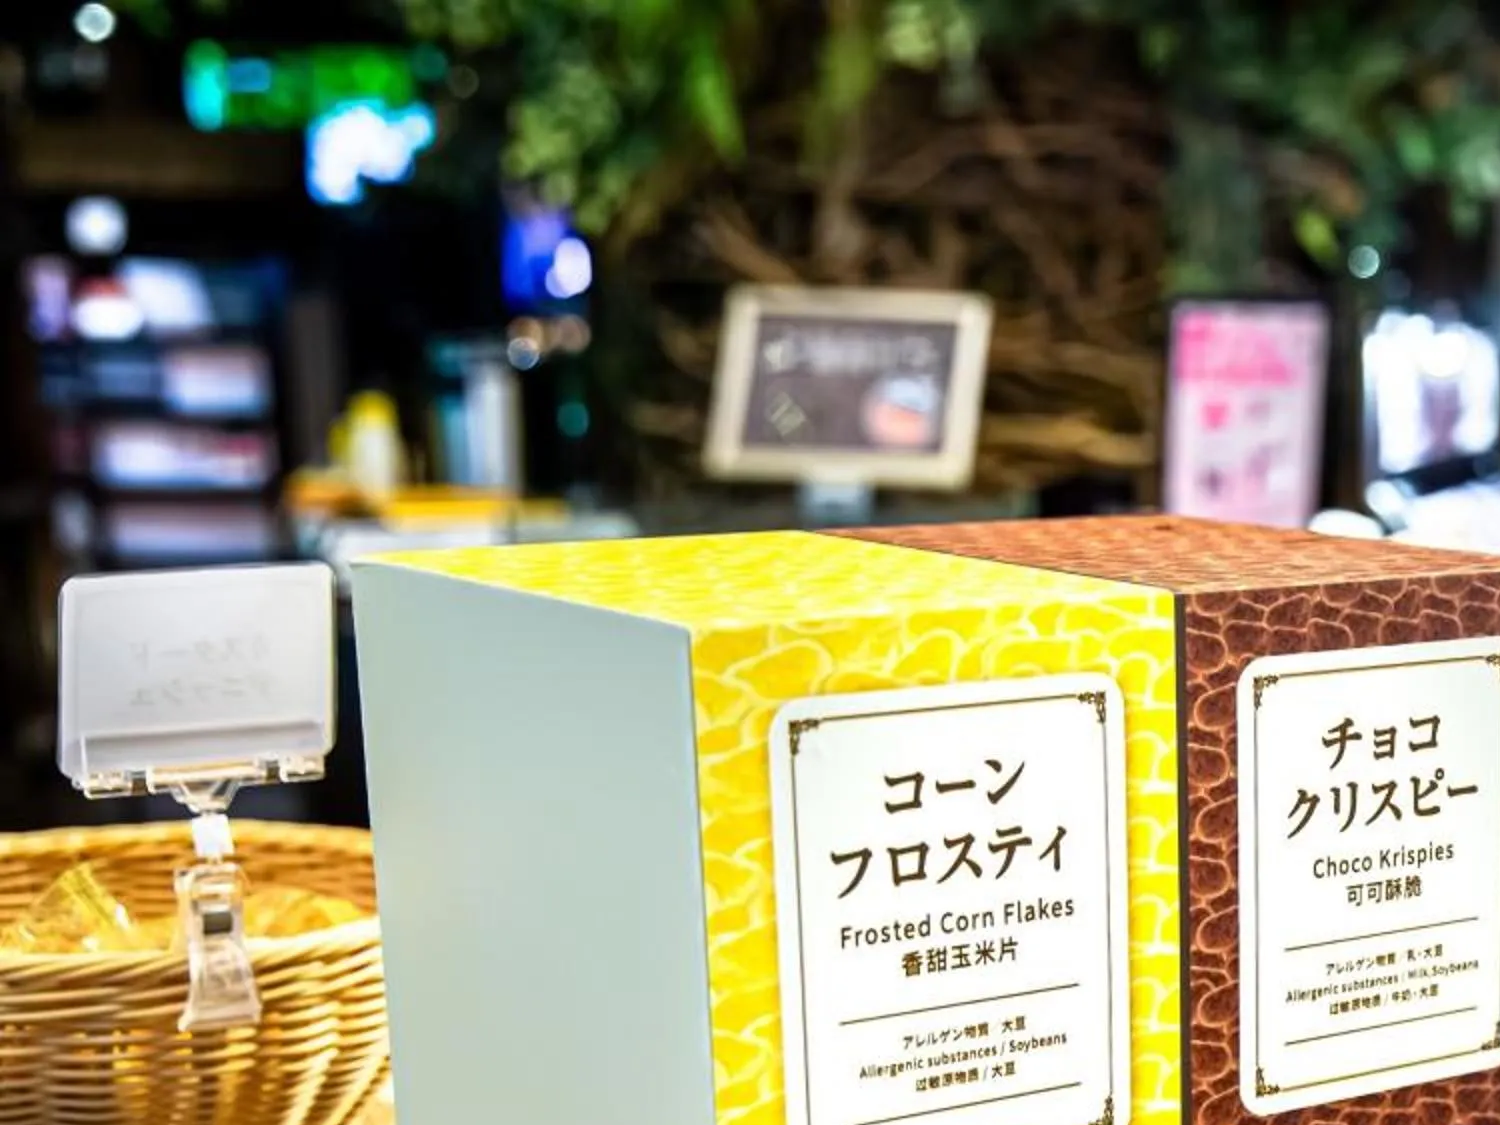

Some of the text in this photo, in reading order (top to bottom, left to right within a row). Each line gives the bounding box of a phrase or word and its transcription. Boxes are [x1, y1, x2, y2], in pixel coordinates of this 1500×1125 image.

[1321, 713, 1441, 770] チョコ
[883, 757, 1026, 814] コーン
[1287, 768, 1479, 840] クリスピー
[830, 824, 1069, 899] フロスティ
[1312, 841, 1455, 880] Choco Krispies
[1346, 875, 1422, 906] 可可酥脆
[840, 897, 1075, 950] Frosted Corn Flakes
[900, 938, 1019, 978] 香甜玉米片
[859, 1057, 924, 1079] Allergenic
[927, 1044, 998, 1068] substances
[1009, 1032, 1068, 1054] Soybeans
